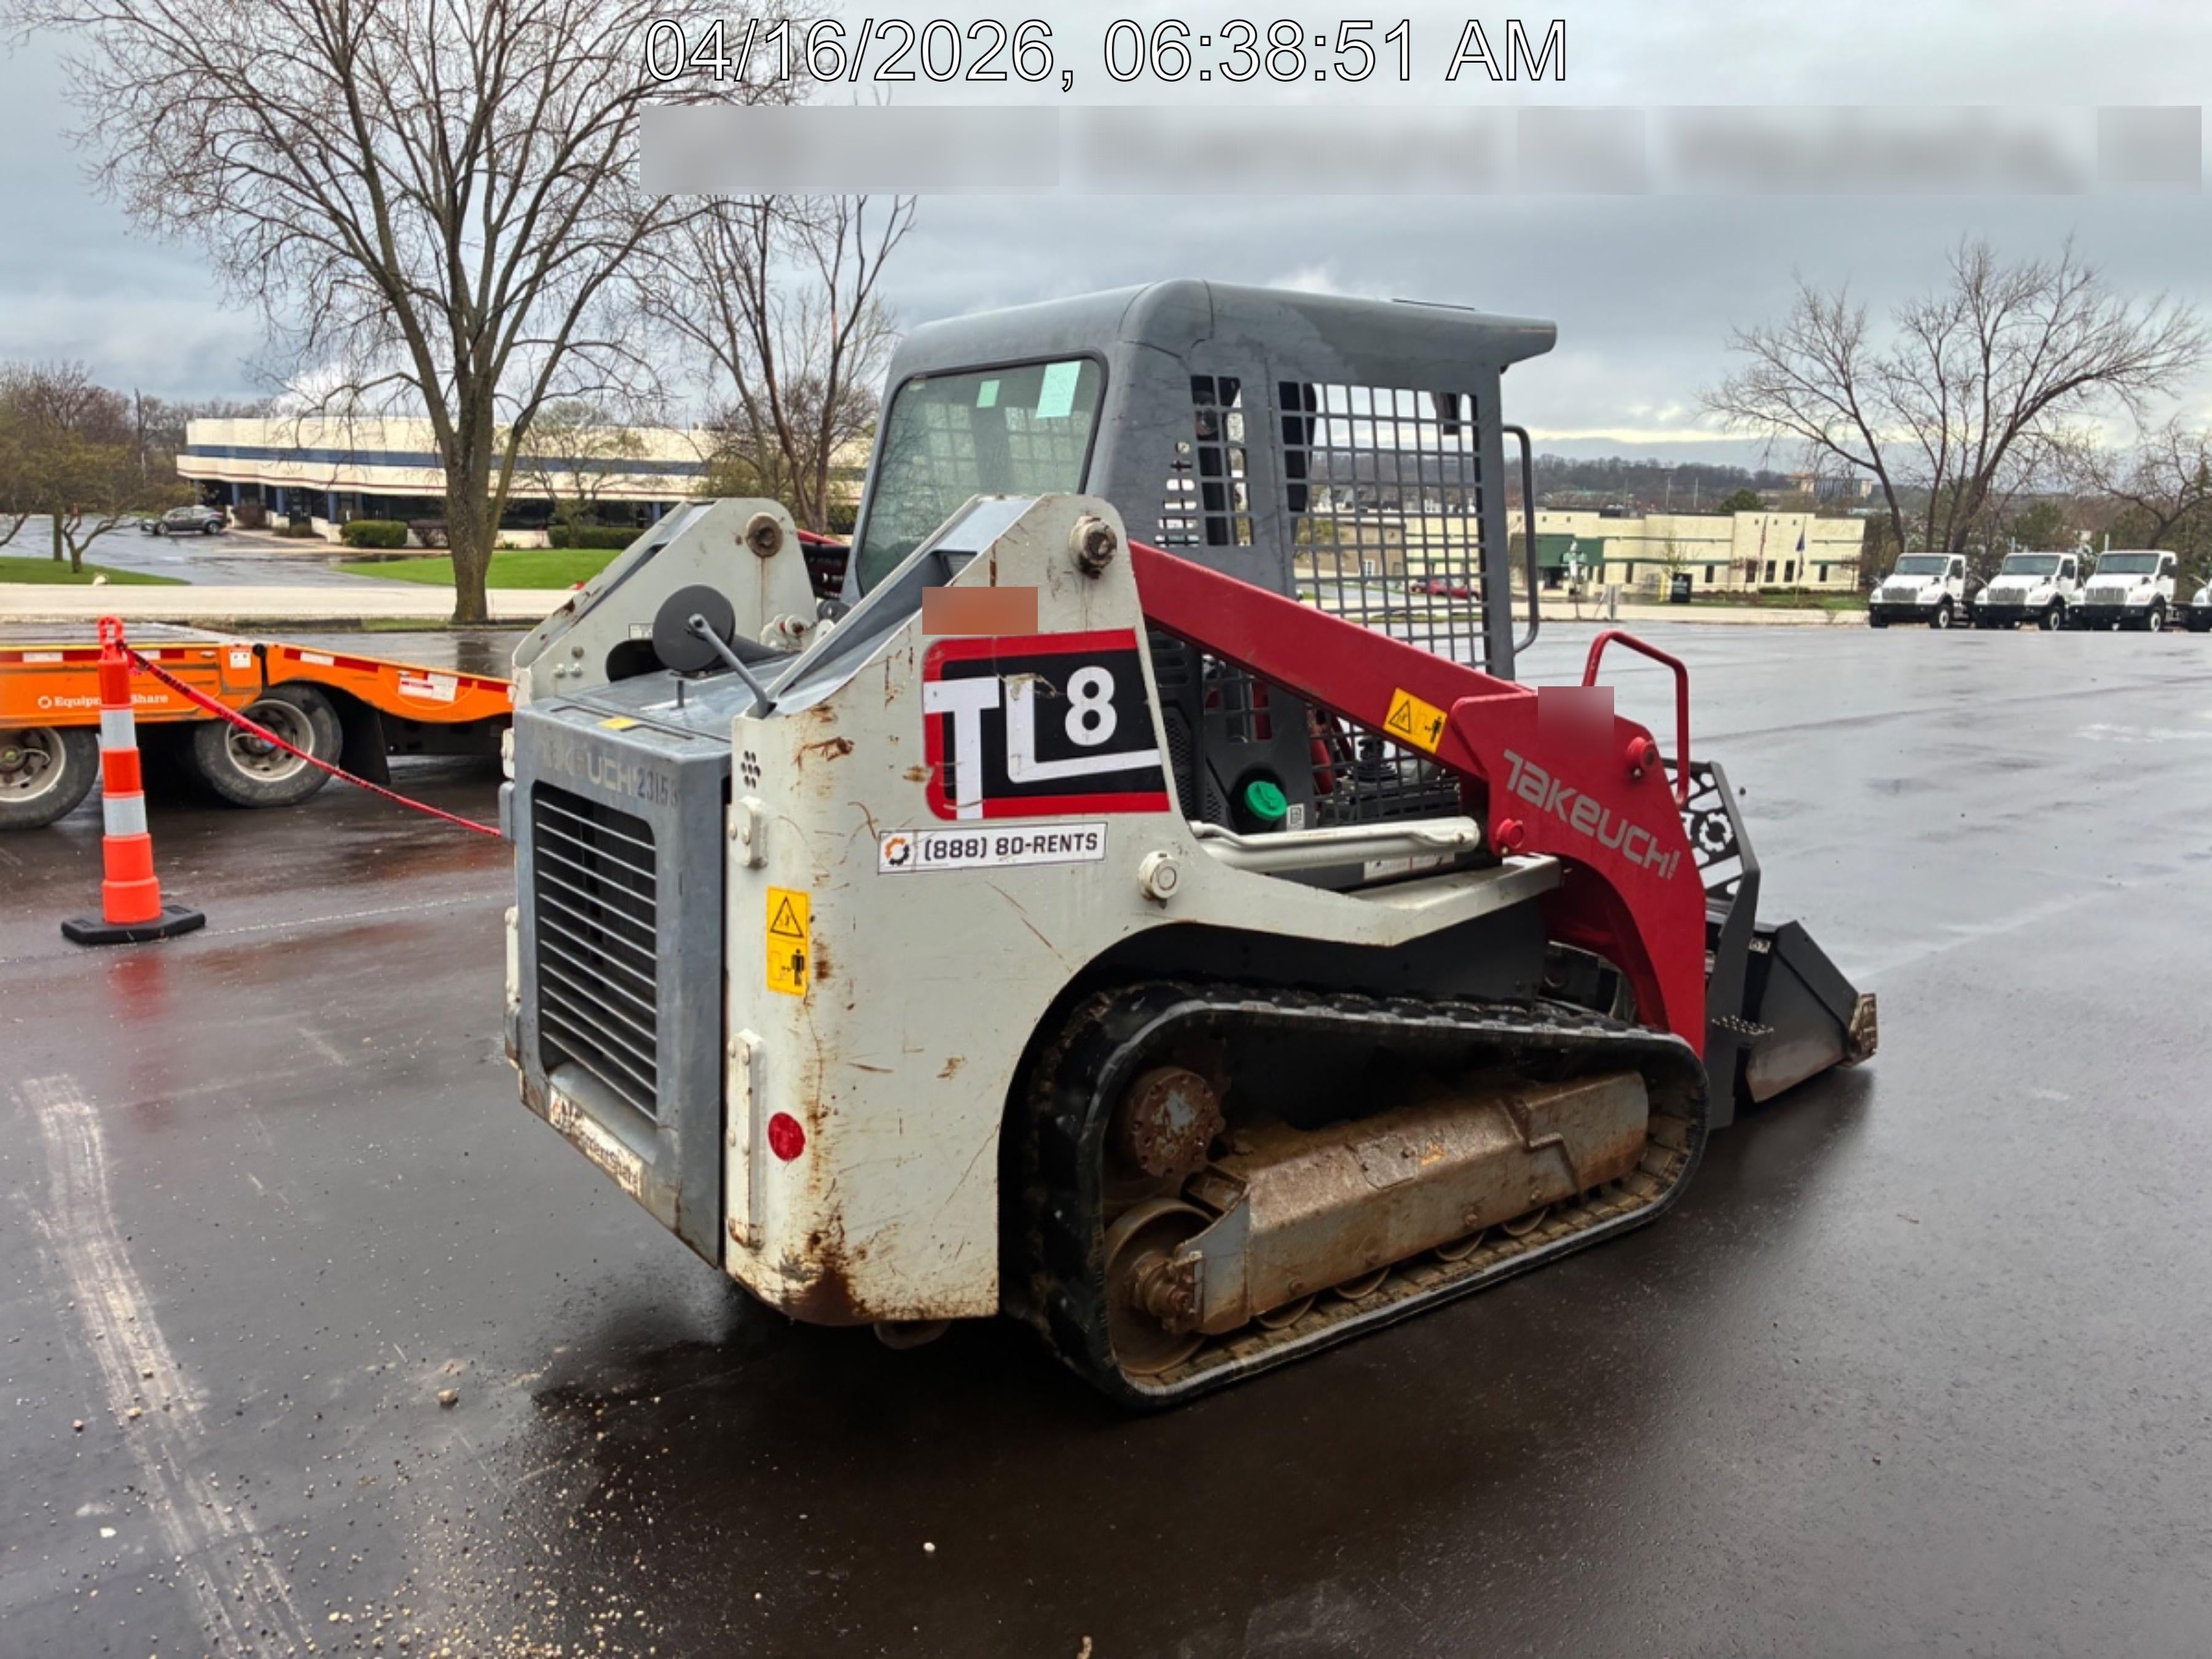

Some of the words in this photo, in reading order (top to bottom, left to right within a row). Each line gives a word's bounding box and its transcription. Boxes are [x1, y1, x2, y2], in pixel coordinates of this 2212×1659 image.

[54, 693, 169, 708] EquipmShare
[924, 665, 1163, 820] TL8
[924, 836, 987, 861] (888)
[995, 832, 1098, 855] 80-RENTS
